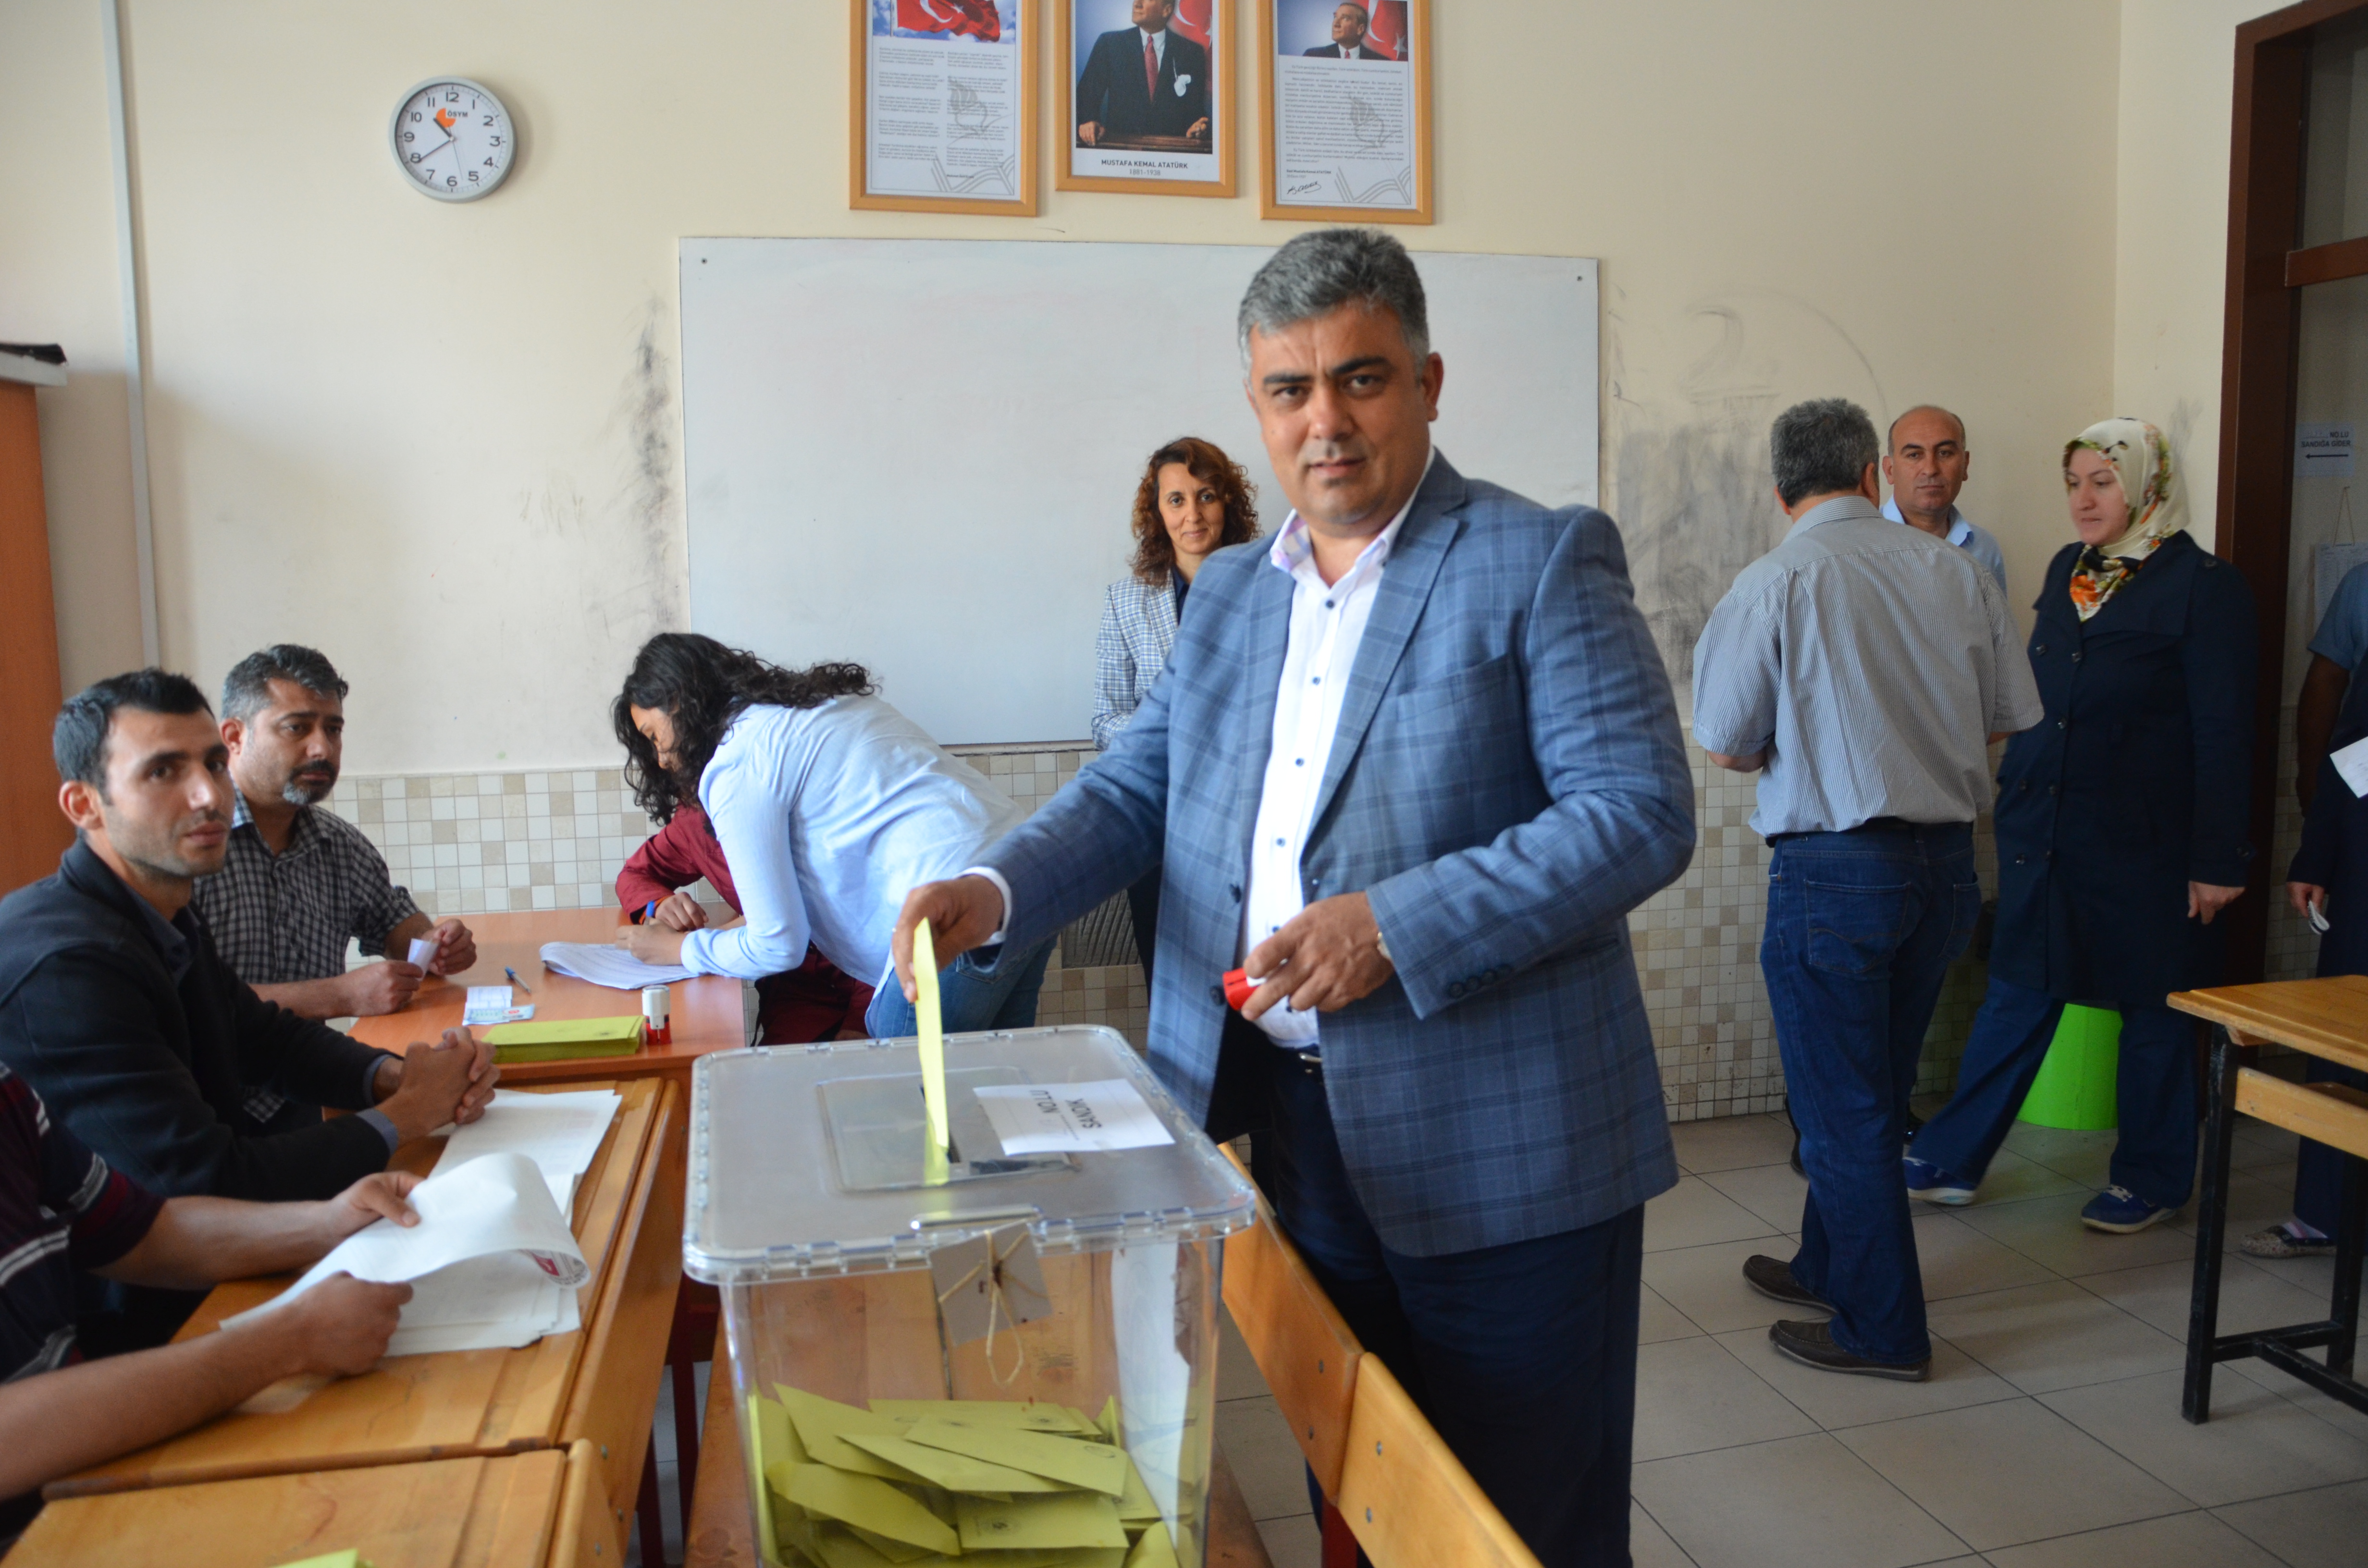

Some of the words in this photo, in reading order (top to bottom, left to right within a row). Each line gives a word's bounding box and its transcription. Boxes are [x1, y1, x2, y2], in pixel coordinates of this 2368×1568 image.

[428, 97, 435, 107] 11
[446, 92, 459, 102] 12
[472, 99, 475, 109] 1
[411, 112, 422, 122] 10
[483, 115, 493, 126] 2
[404, 132, 415, 142] 9
[490, 136, 501, 147] 3
[410, 153, 421, 163] 8
[483, 157, 493, 167] 4
[426, 170, 435, 180] 7
[468, 171, 479, 182] 5
[447, 176, 457, 186] 6
[1065, 1098, 1103, 1128] SANDIK
